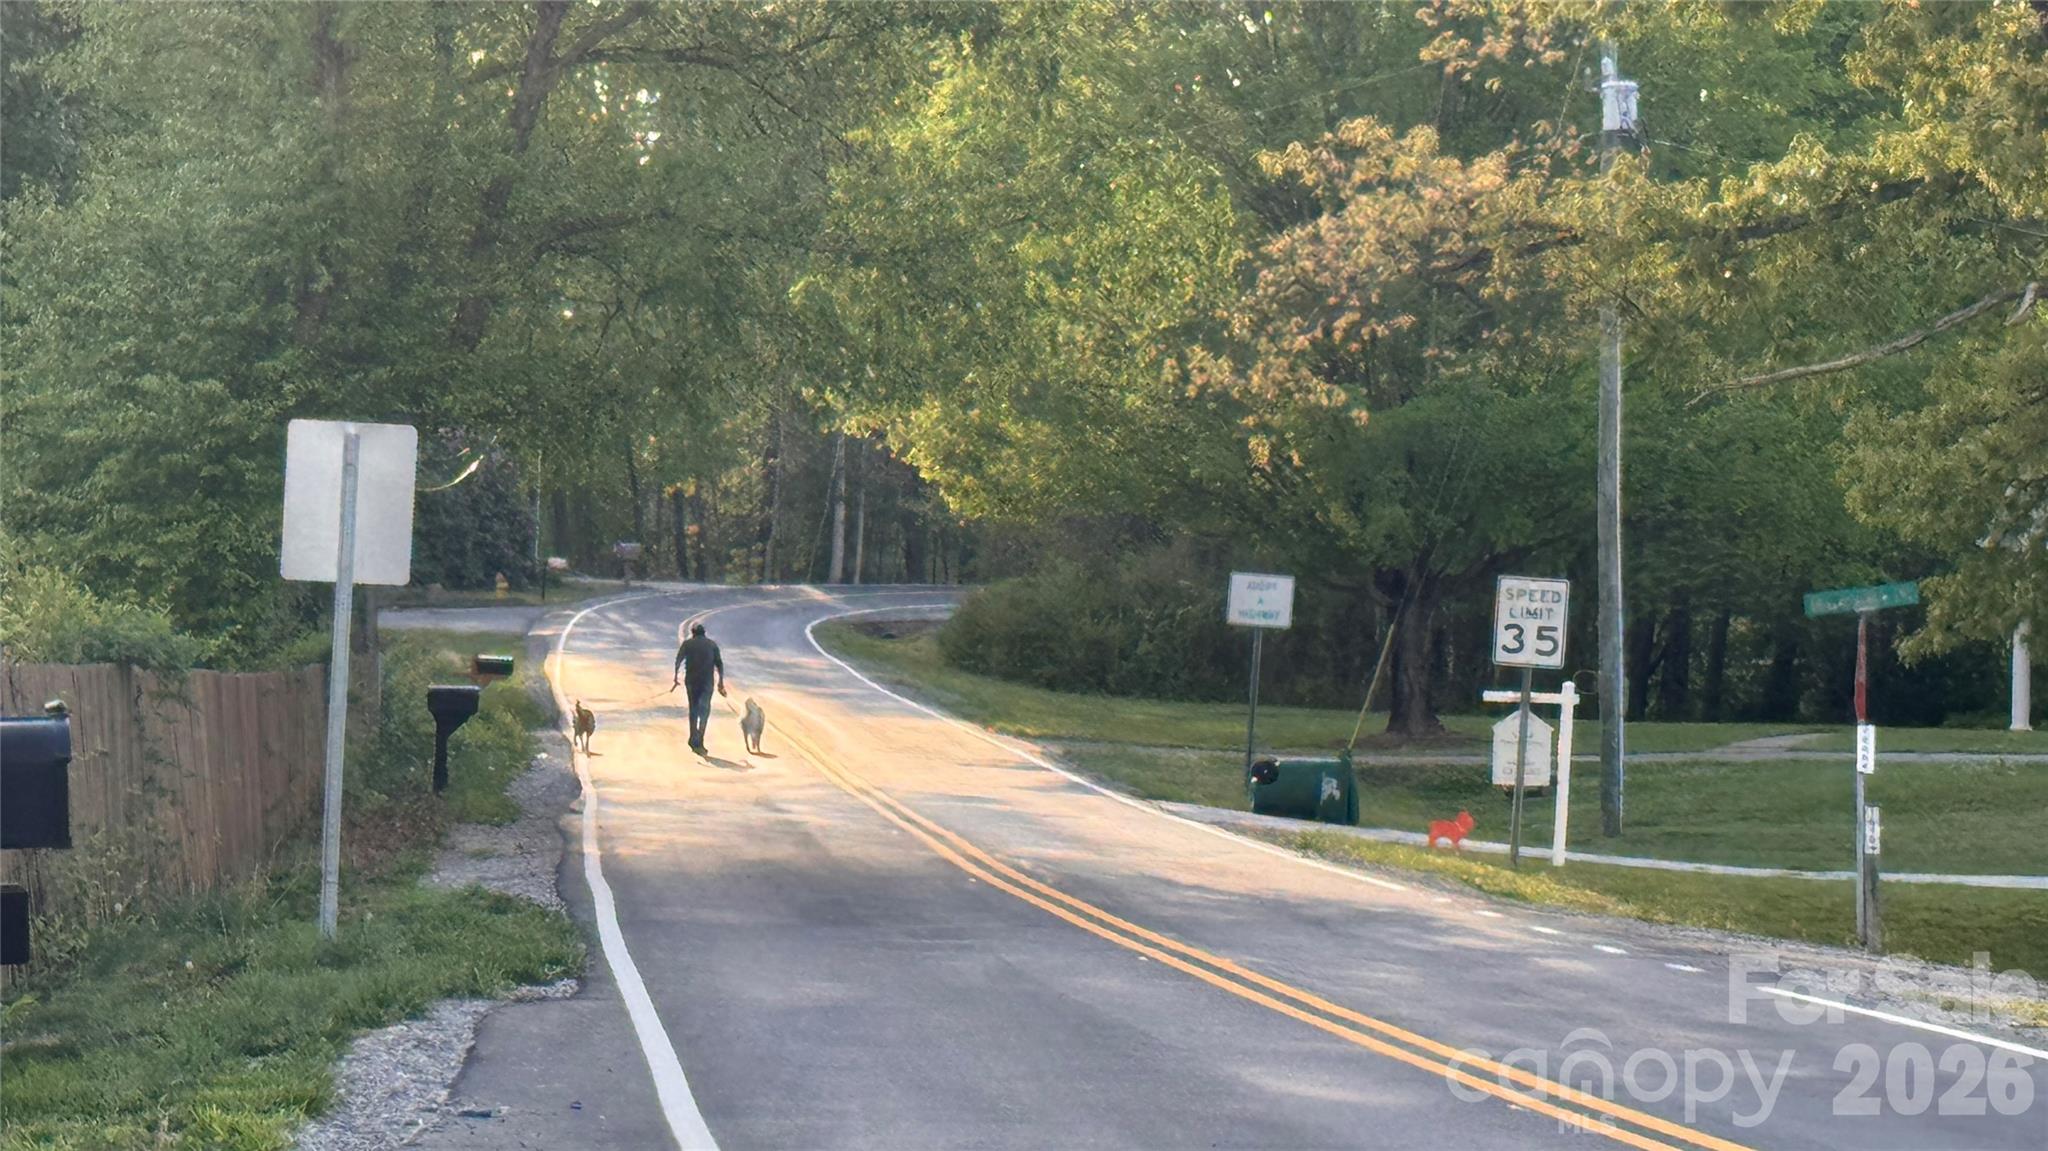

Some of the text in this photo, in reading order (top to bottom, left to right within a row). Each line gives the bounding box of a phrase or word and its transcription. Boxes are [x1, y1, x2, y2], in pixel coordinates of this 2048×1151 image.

[1505, 588, 1561, 603] SPEED
[1509, 607, 1555, 620] LIMIT
[1501, 623, 1560, 657] 35
